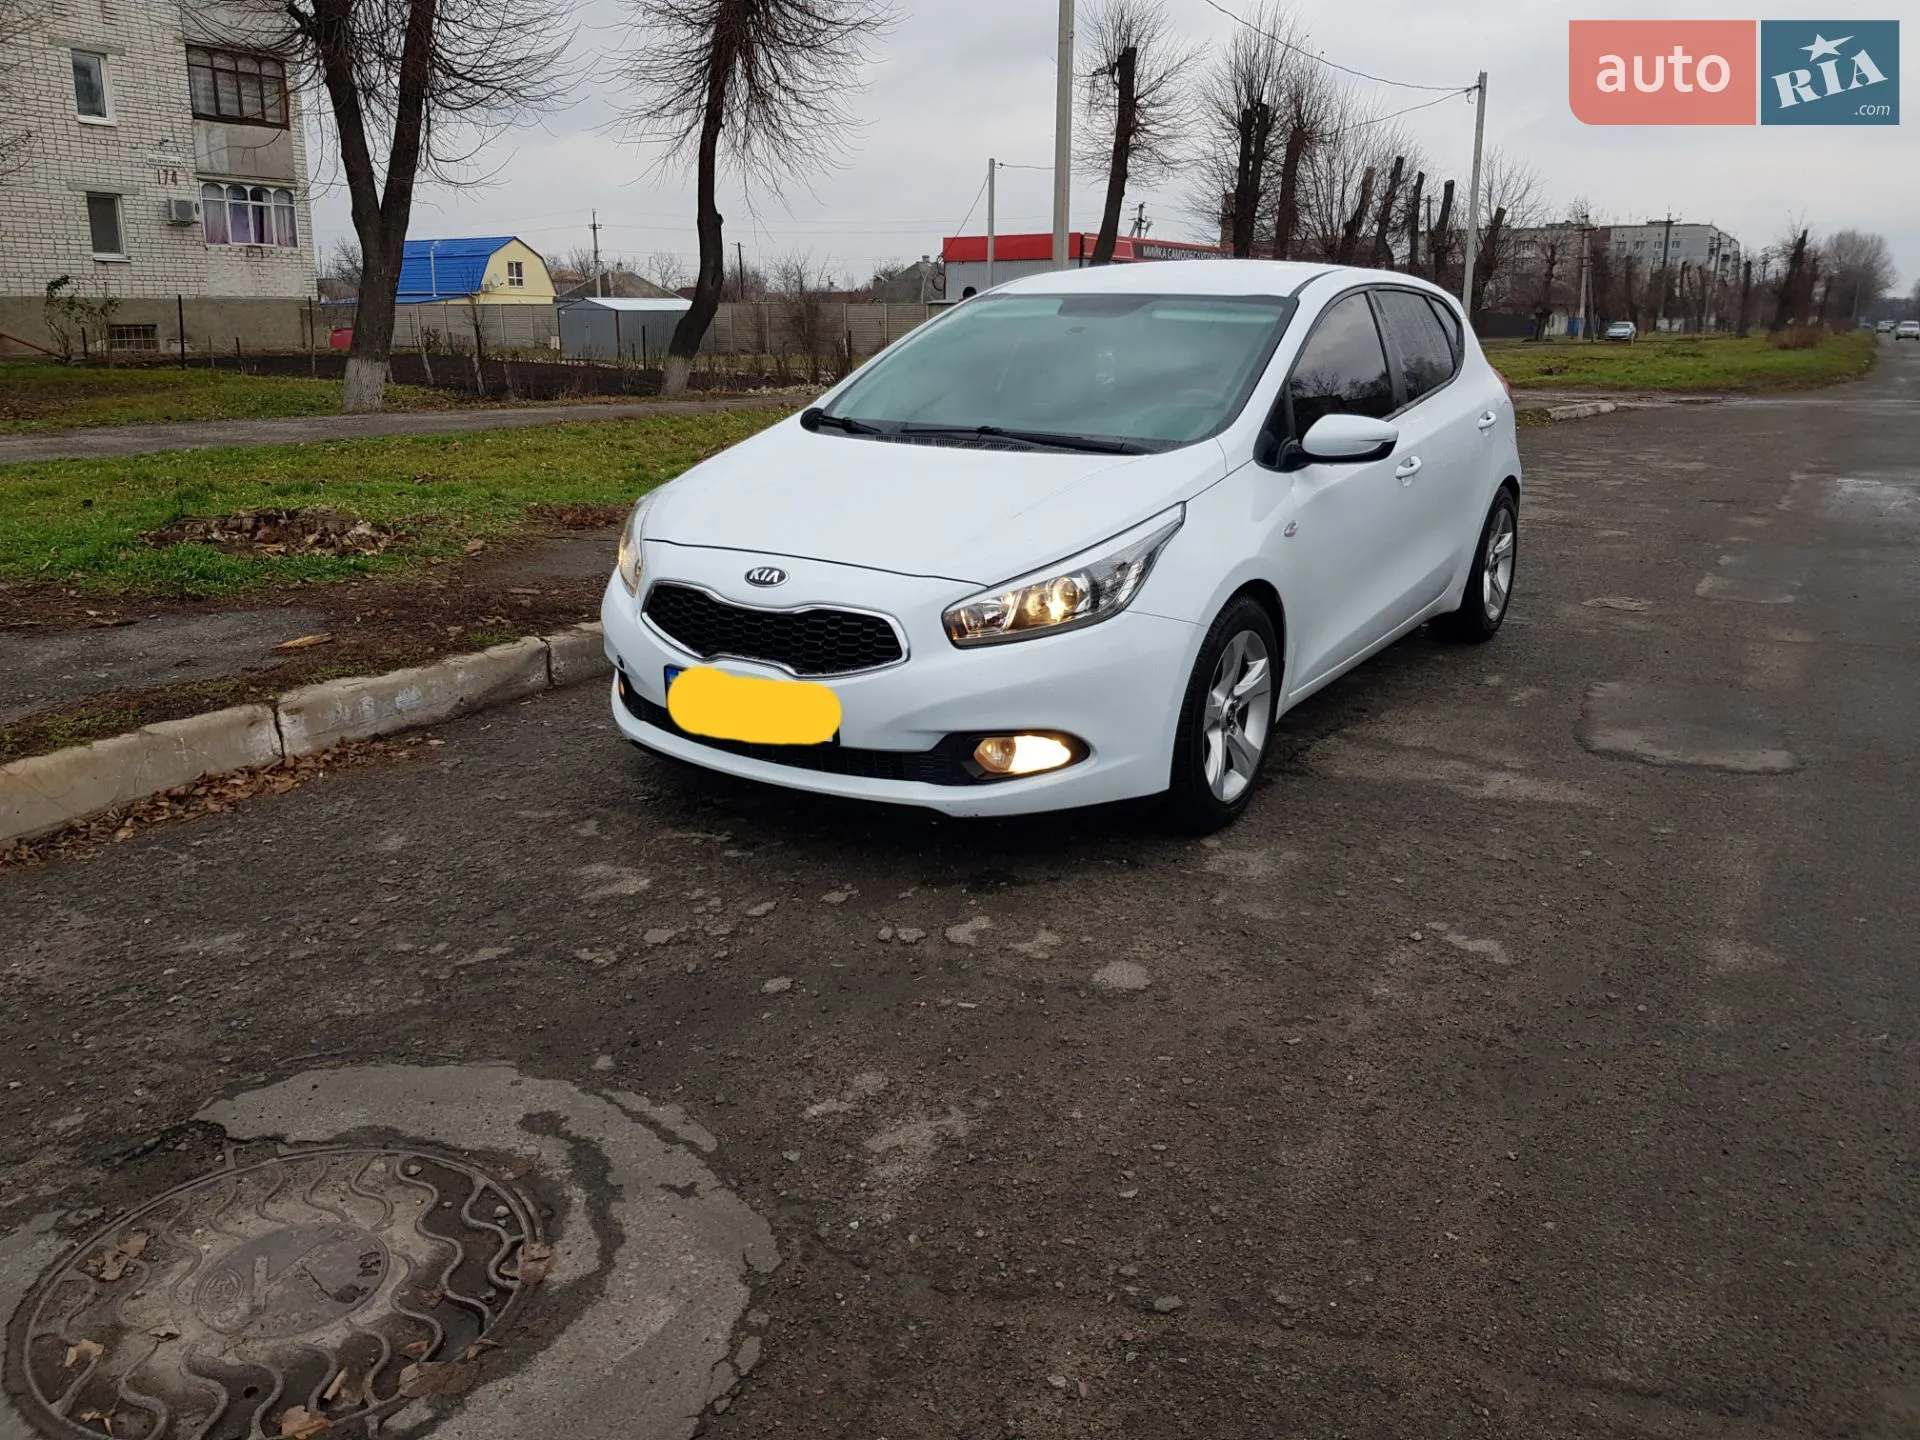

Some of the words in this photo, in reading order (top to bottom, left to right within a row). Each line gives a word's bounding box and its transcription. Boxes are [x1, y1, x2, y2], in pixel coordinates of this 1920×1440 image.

[157, 169, 178, 185] 174
[1143, 245, 1167, 259] МИЙКА
[749, 568, 779, 583] KIA
